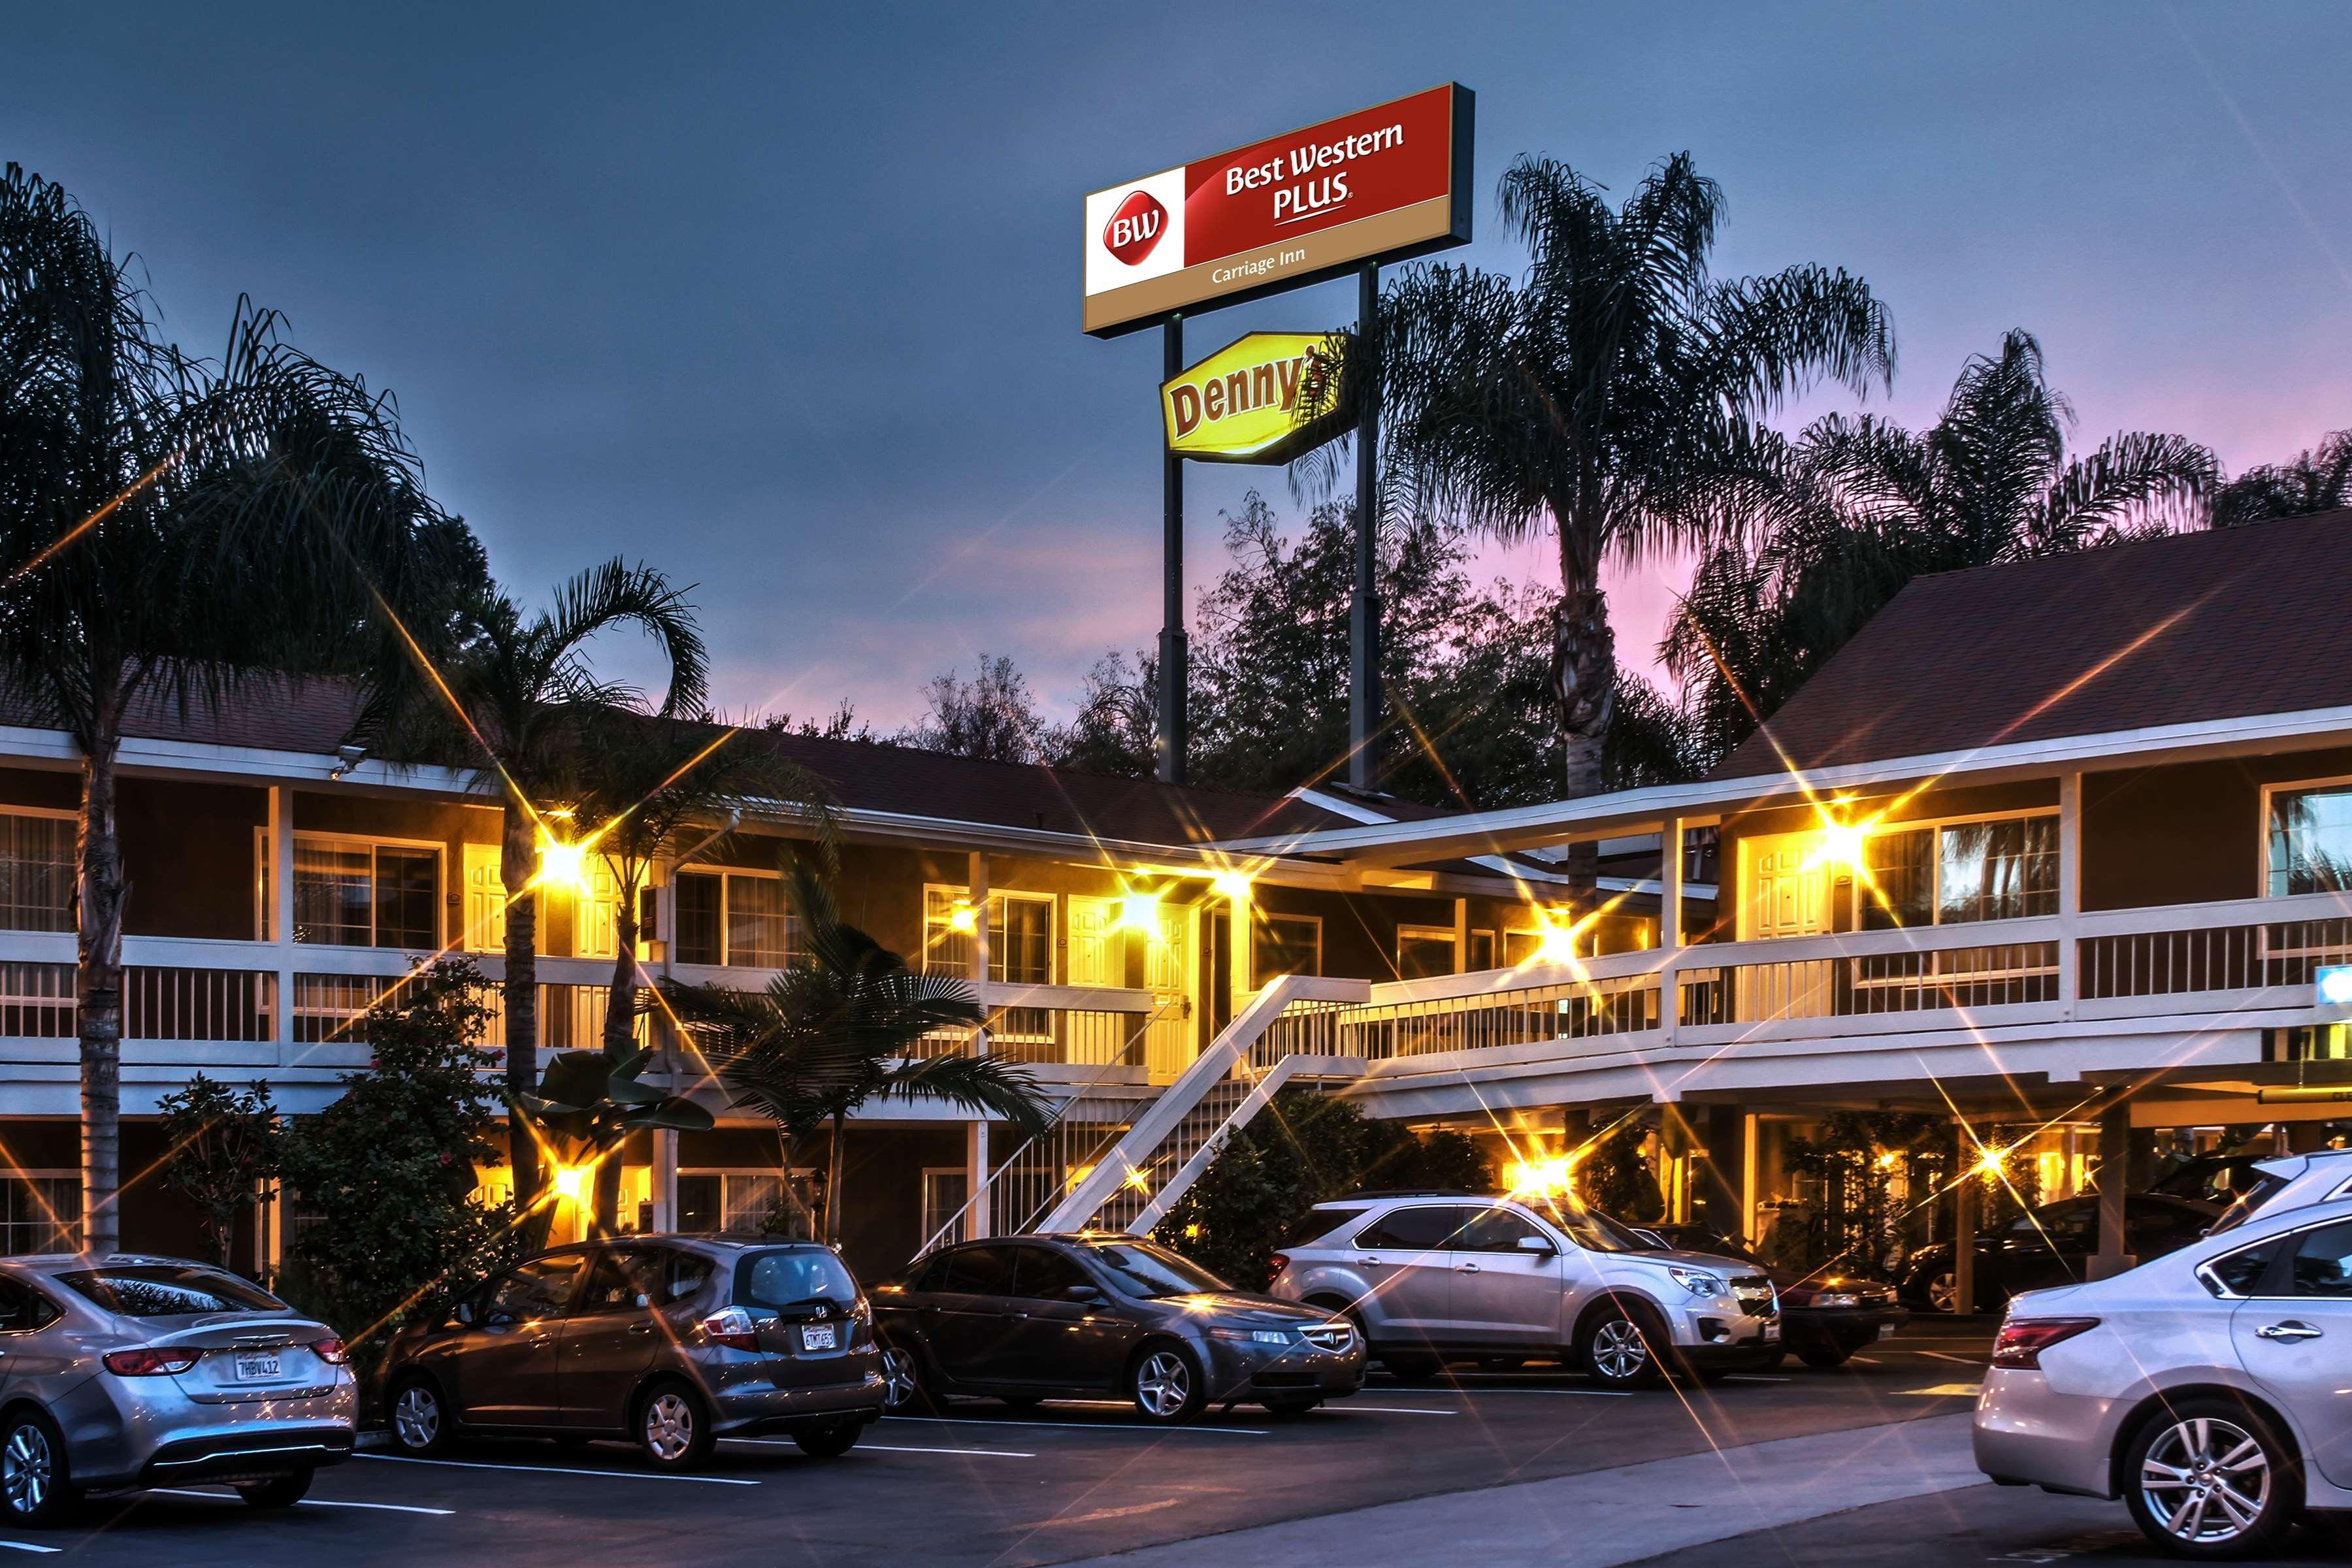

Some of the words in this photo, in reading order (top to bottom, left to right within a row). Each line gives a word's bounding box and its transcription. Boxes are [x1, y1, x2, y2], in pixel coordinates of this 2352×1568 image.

[1226, 157, 1285, 195] Best
[1290, 123, 1404, 176] Western
[1274, 171, 1348, 220] PLUS
[1113, 209, 1160, 248] BW
[1212, 257, 1275, 284] Carriage
[1280, 248, 1306, 266] Inn
